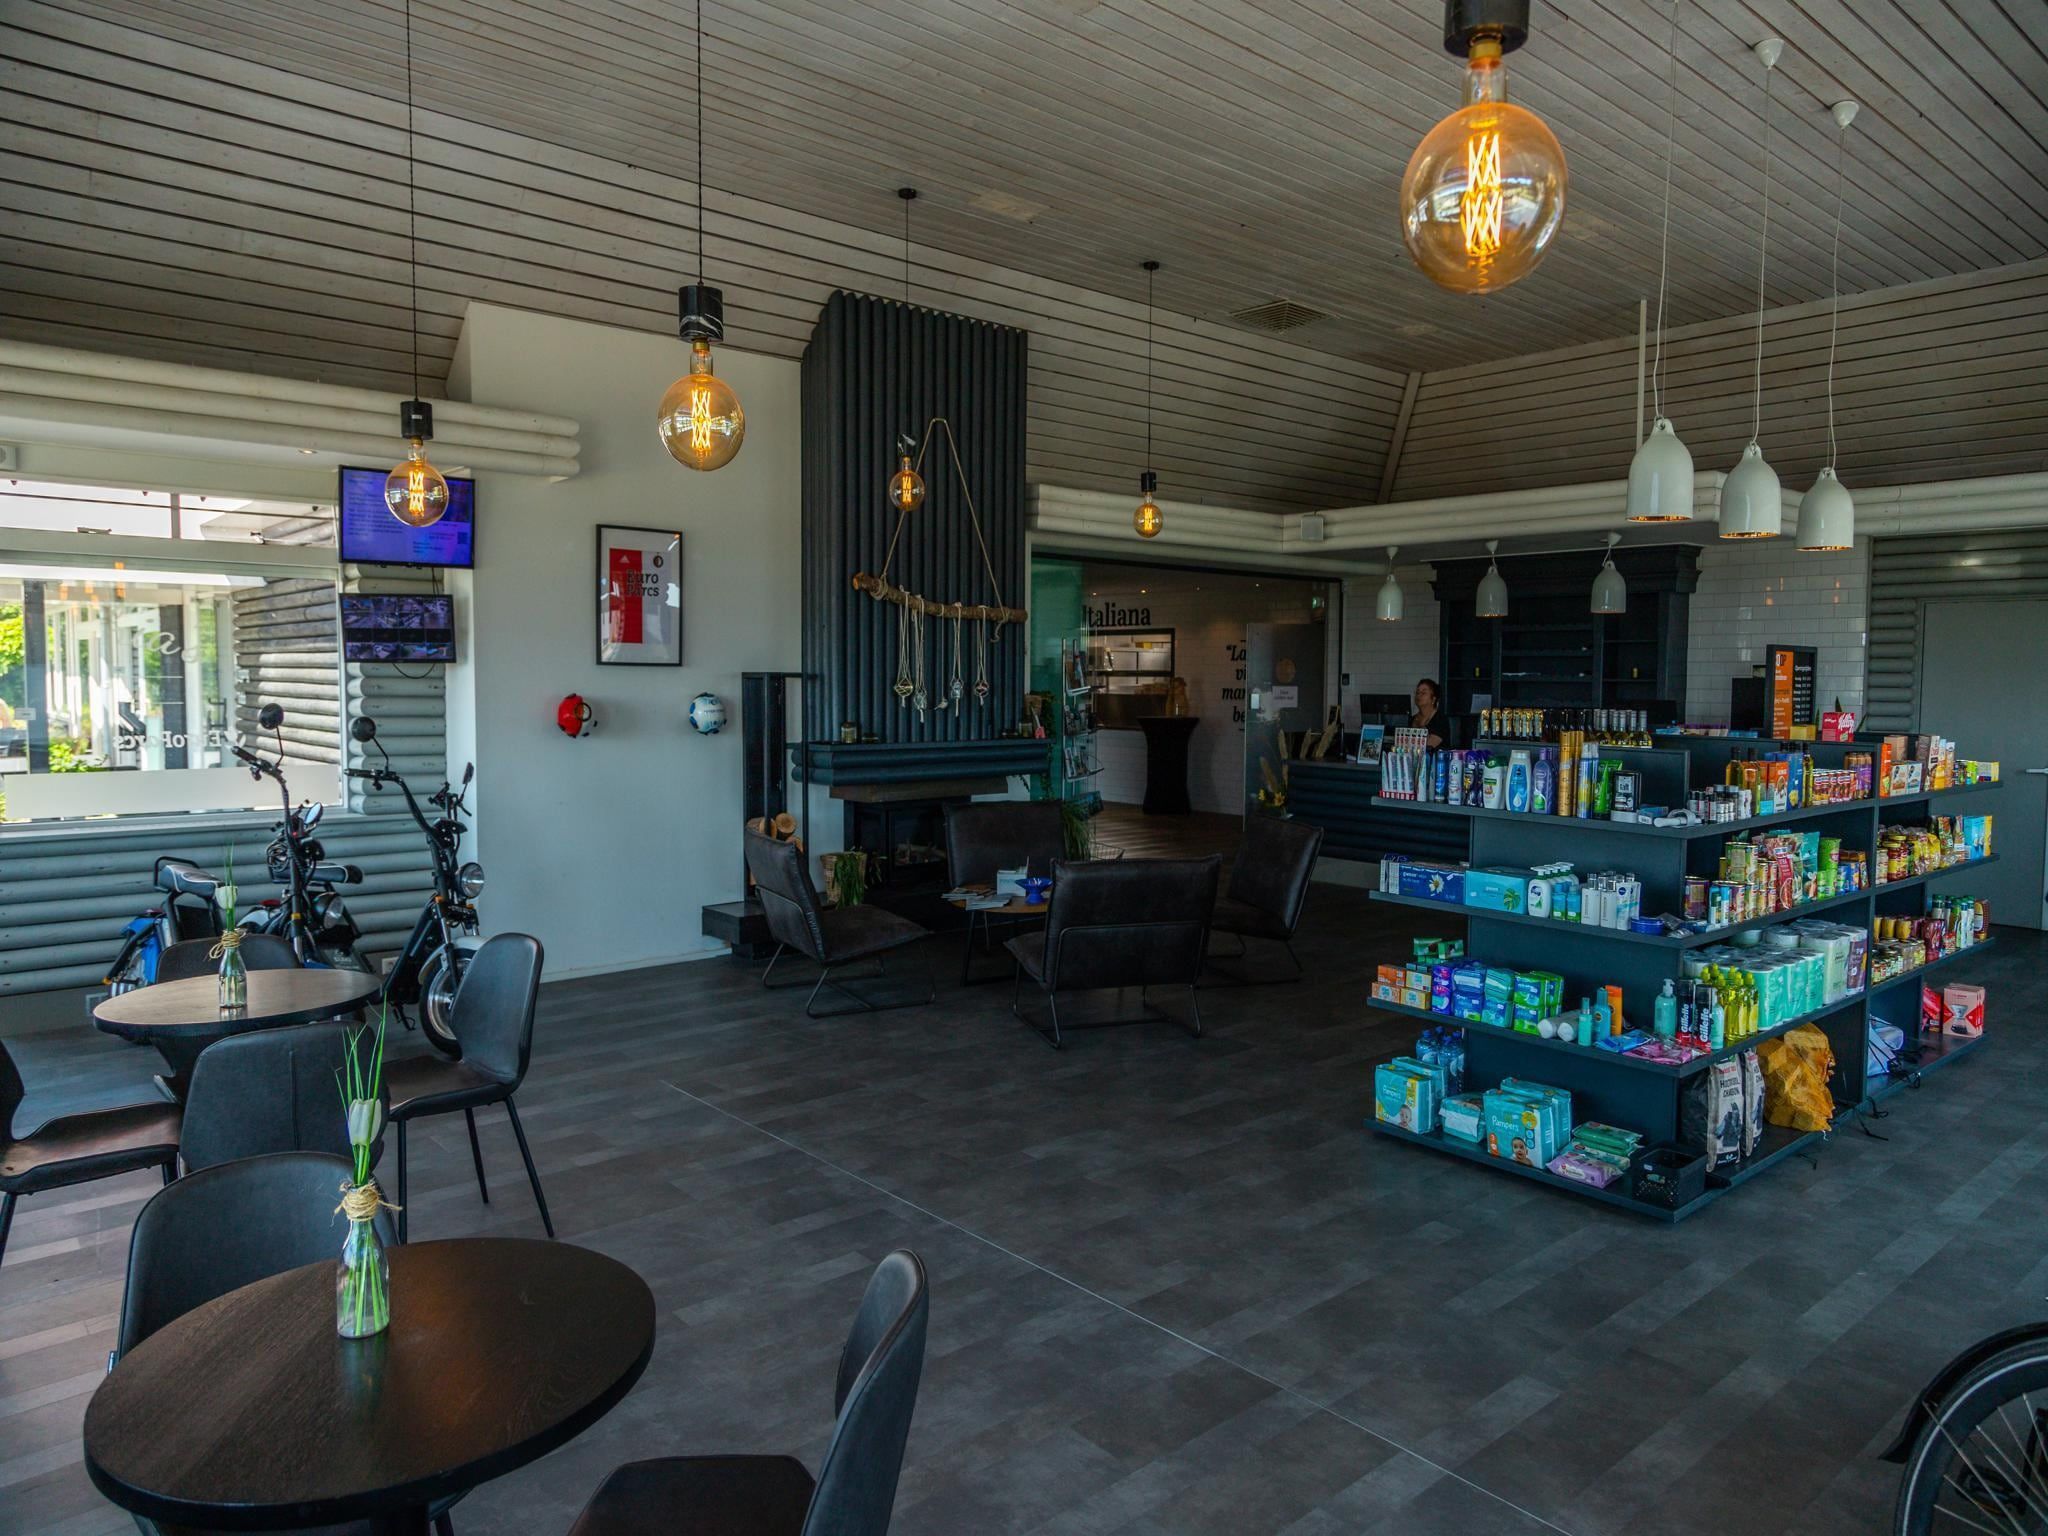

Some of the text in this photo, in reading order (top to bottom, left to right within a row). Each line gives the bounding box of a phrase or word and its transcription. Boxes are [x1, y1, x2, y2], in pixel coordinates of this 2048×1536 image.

[626, 569, 659, 584] Euro
[1082, 602, 1151, 627] Italiana
[1681, 1003, 1689, 1033] Gillette
[1699, 1008, 1709, 1042] Gillette
[1492, 1115, 1519, 1132] Pampers
